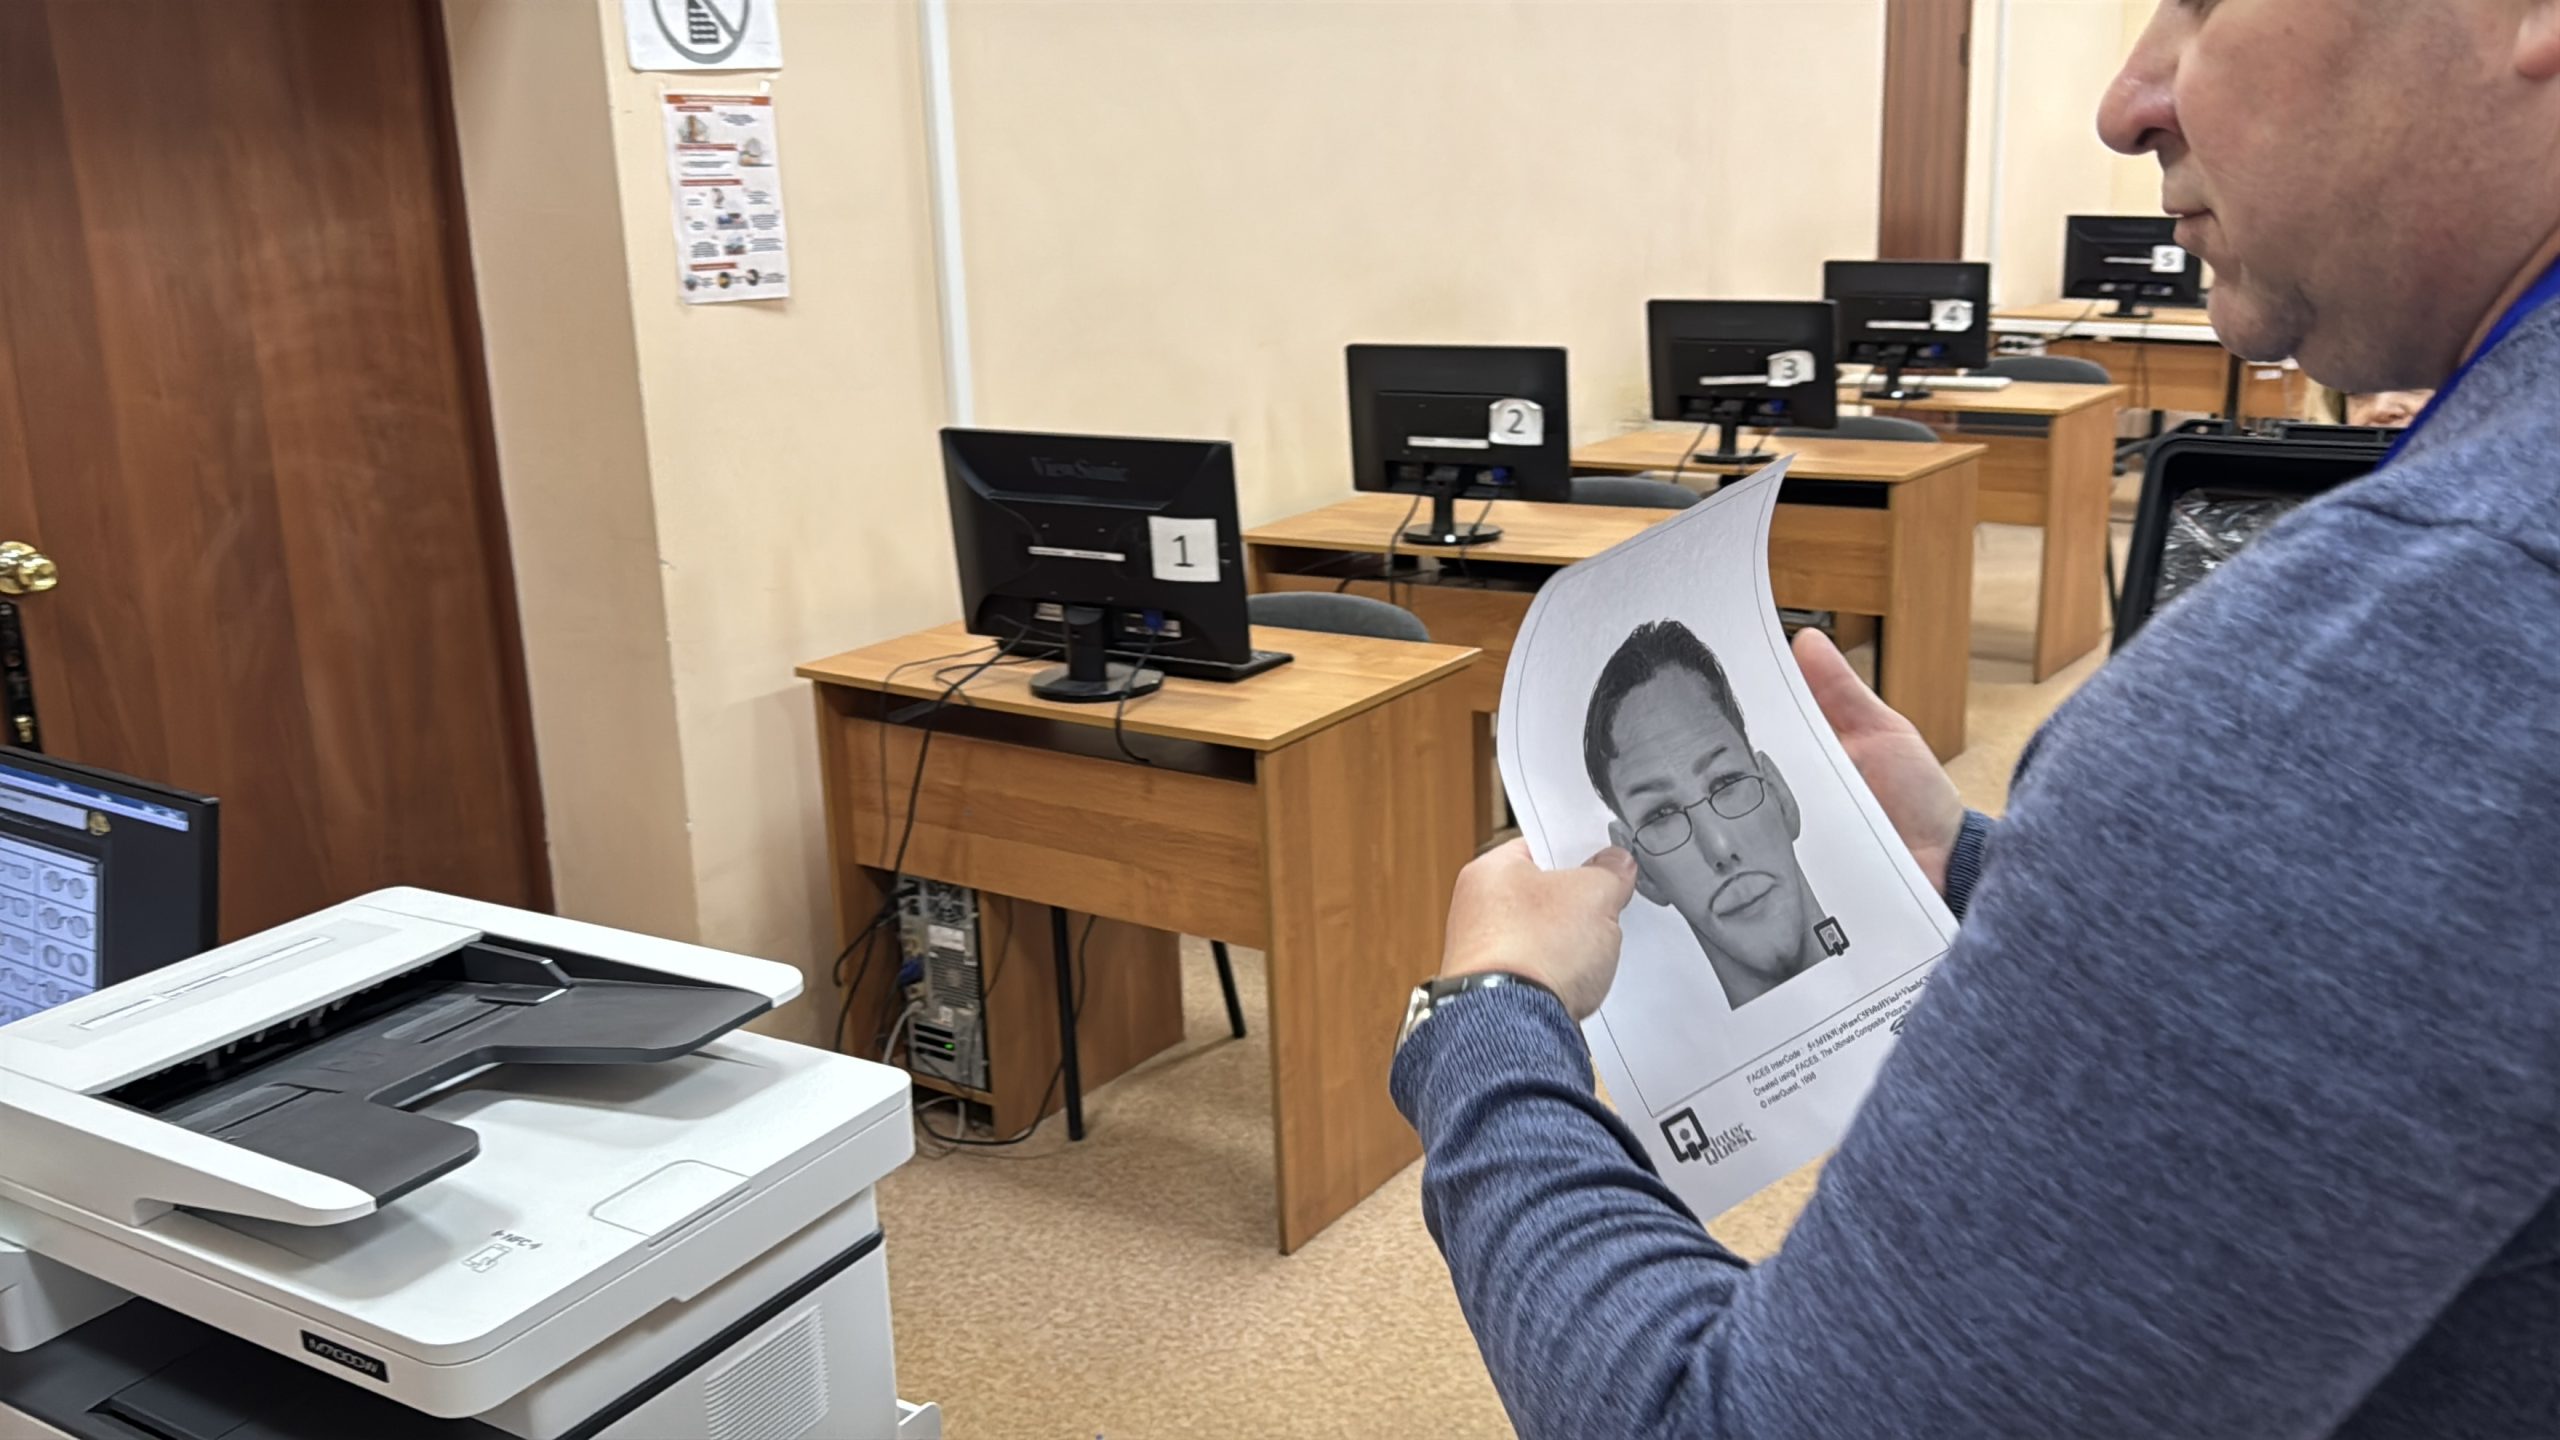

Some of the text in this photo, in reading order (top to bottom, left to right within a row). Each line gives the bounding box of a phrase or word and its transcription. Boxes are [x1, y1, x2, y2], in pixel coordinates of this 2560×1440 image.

[1941, 304, 1959, 323] 4
[1781, 357, 1798, 379] 3
[1506, 408, 1526, 435] 2
[1172, 534, 1195, 568] 1
[1753, 1078, 1780, 1097] Created
[1778, 1069, 1797, 1083] using
[1819, 1047, 1834, 1058] The
[1832, 1034, 1856, 1052] Ultimate
[1853, 1016, 1887, 1039] Composite
[499, 1233, 533, 1247] NFC
